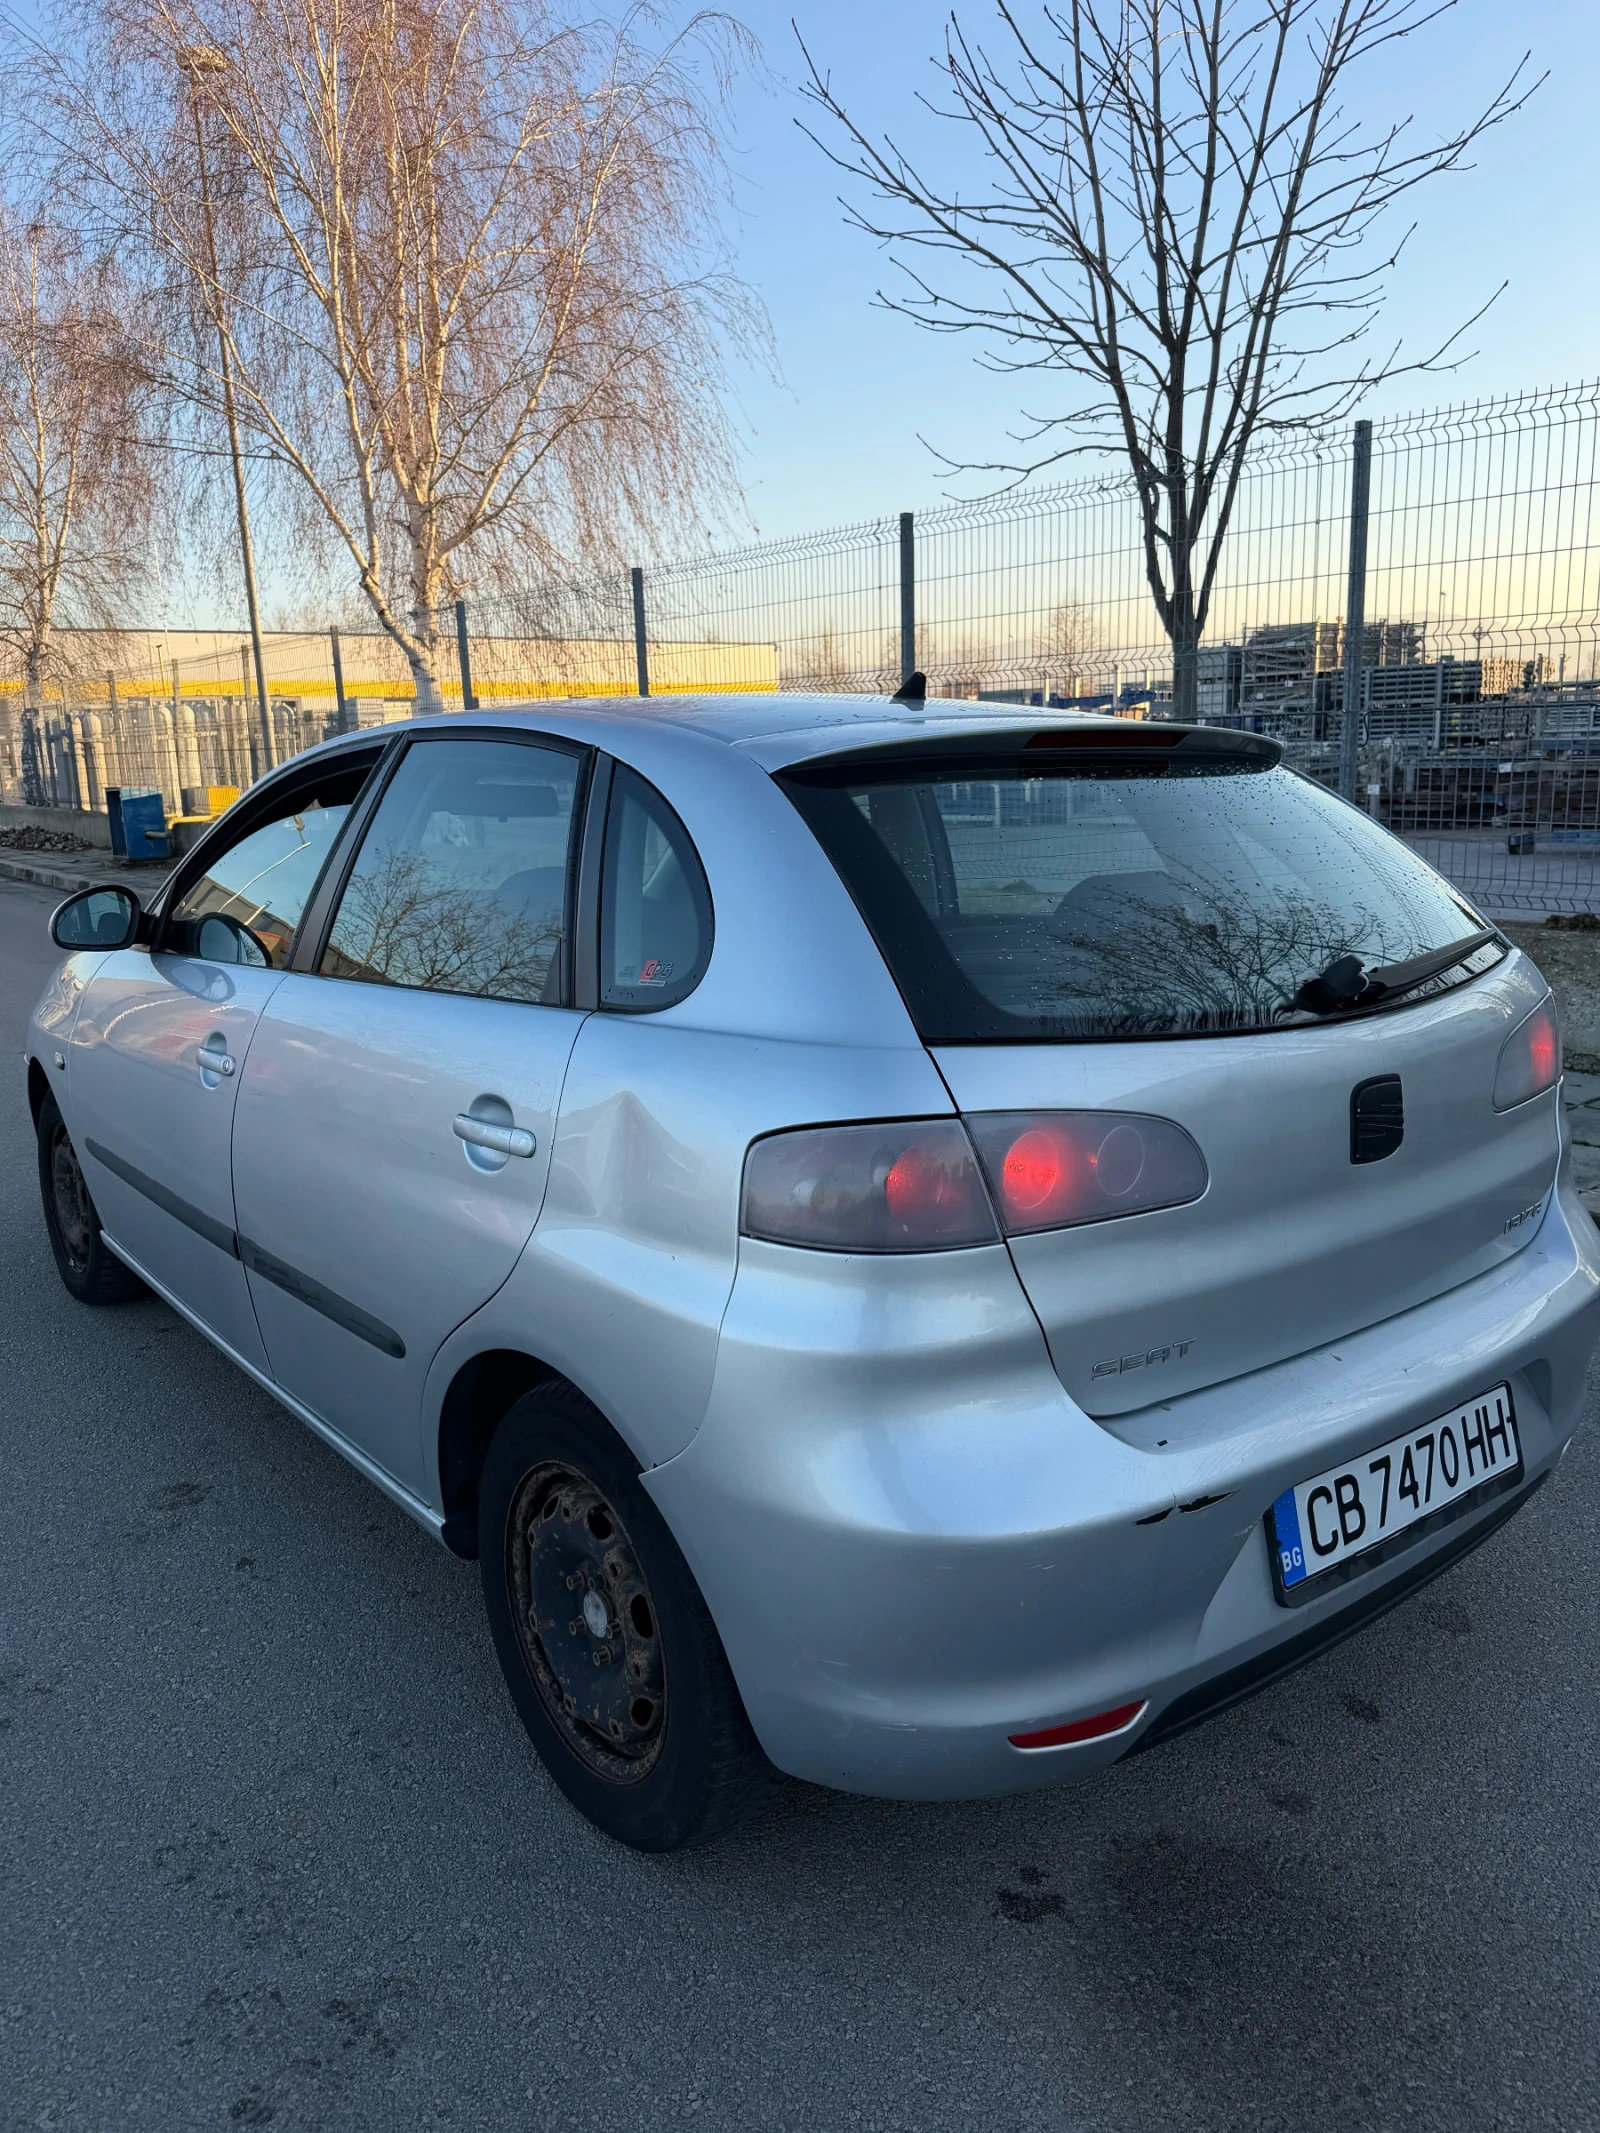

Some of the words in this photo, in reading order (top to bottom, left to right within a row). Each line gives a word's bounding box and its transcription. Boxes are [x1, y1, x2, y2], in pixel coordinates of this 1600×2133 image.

[1091, 1338, 1197, 1381] SEAT
[1306, 1473, 1366, 1557] CB
[1368, 1425, 1459, 1529] 7470
[1460, 1398, 1511, 1478] HH
[1281, 1546, 1302, 1573] BG
